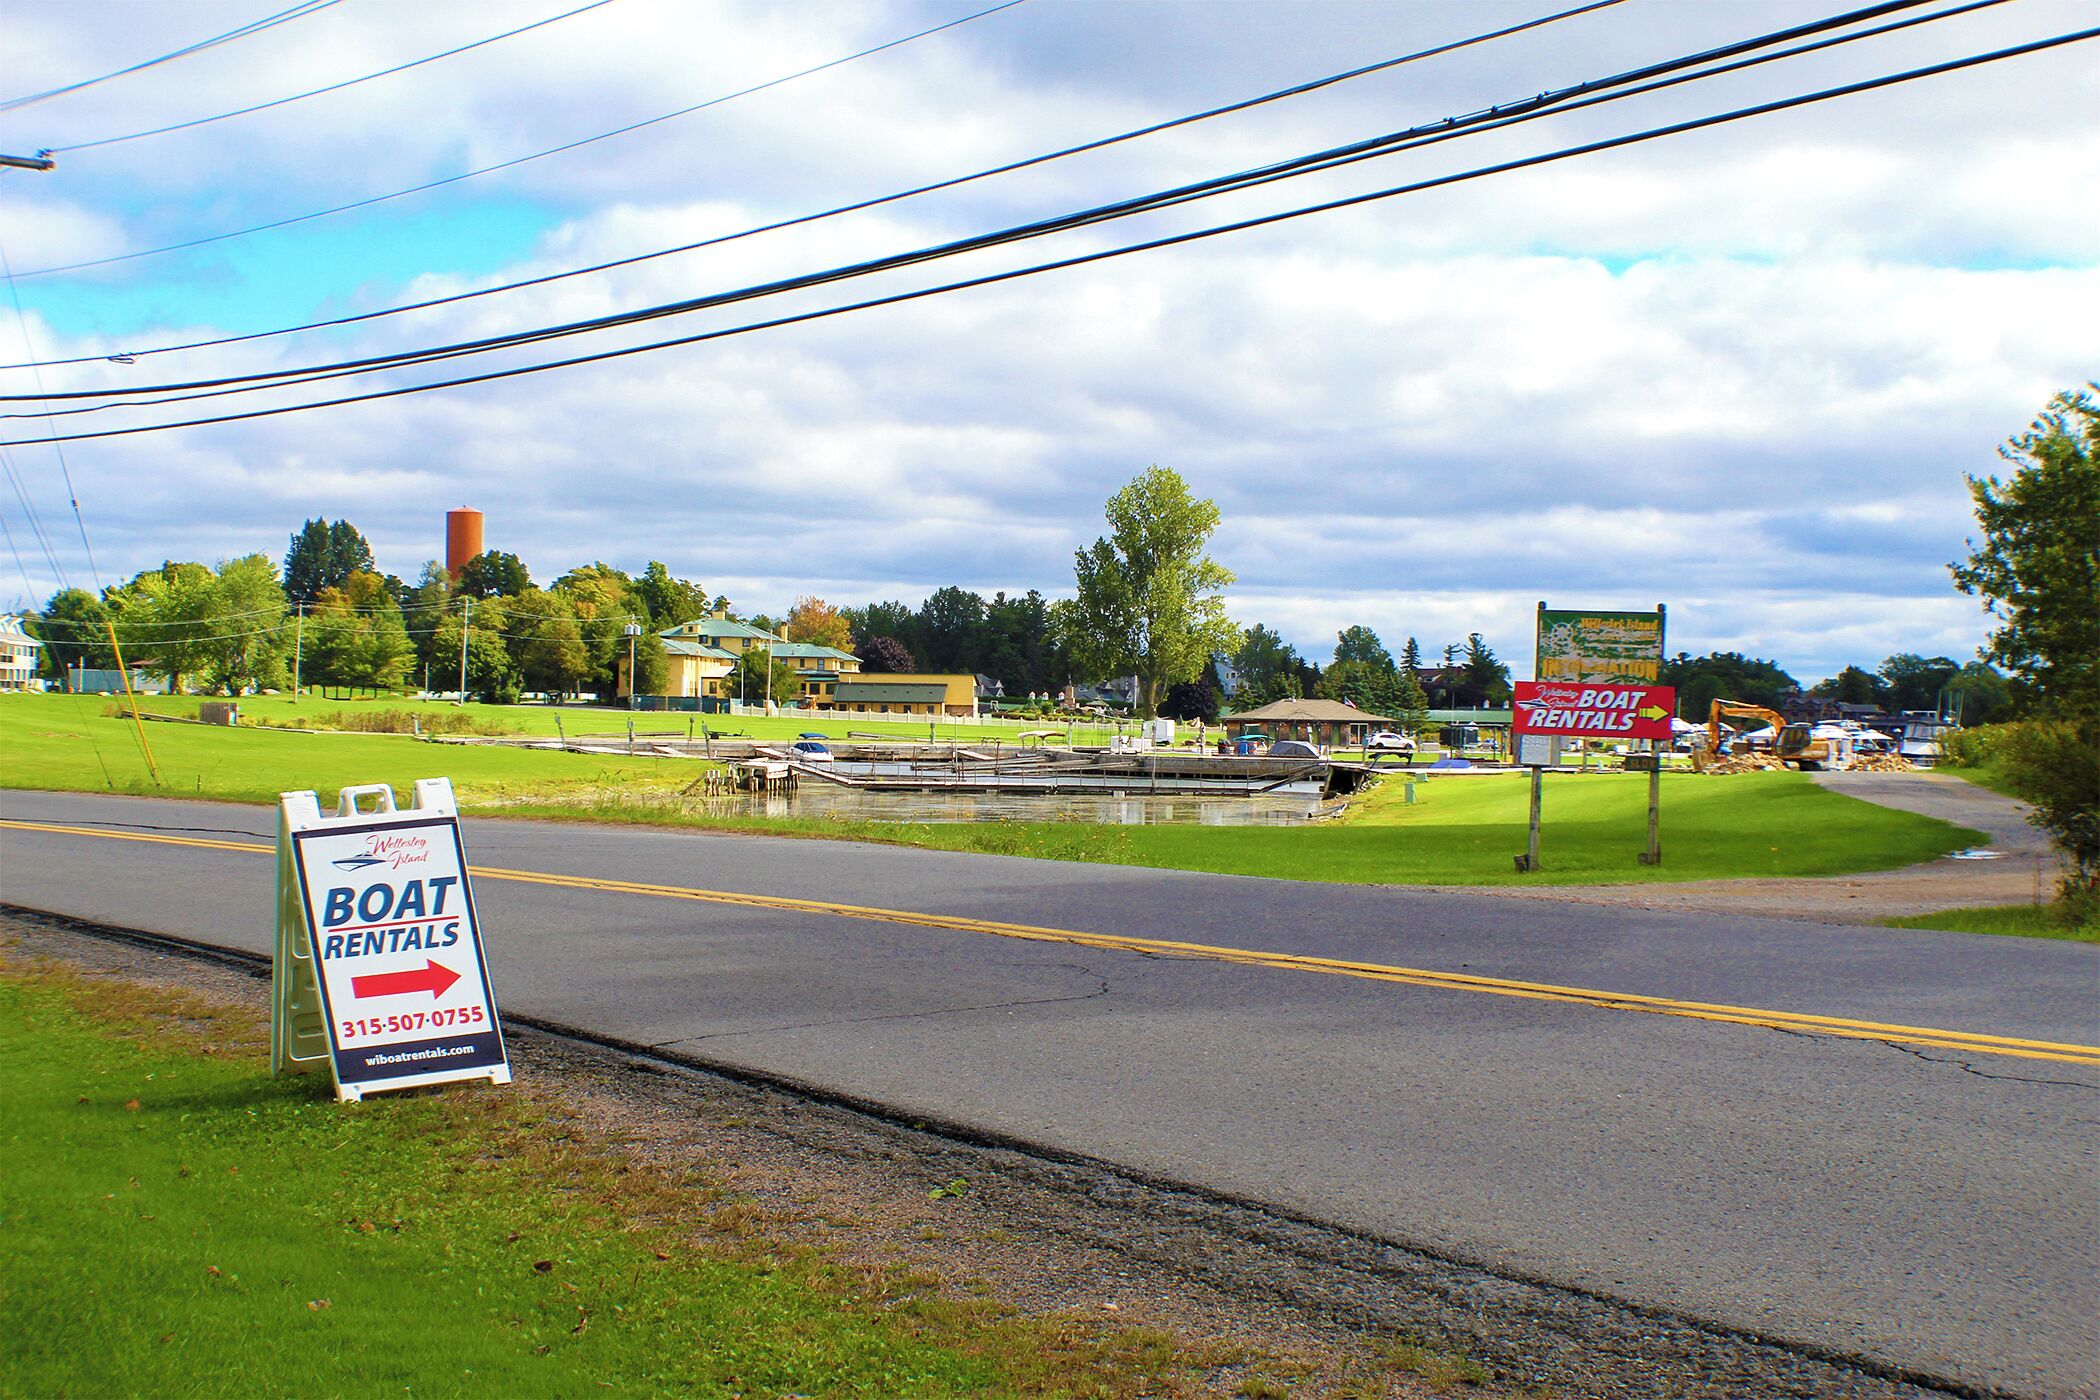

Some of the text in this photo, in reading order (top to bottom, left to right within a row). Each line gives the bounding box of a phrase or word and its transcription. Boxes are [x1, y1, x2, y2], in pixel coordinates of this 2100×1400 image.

[1577, 690, 1647, 710] BOAT
[1528, 709, 1637, 731] RENTALS
[365, 834, 428, 854] Wellesley
[388, 850, 429, 869] Island
[322, 875, 457, 927] BOAT
[324, 922, 460, 960] RENTALS
[365, 1044, 475, 1067] wiboatrentals.com
